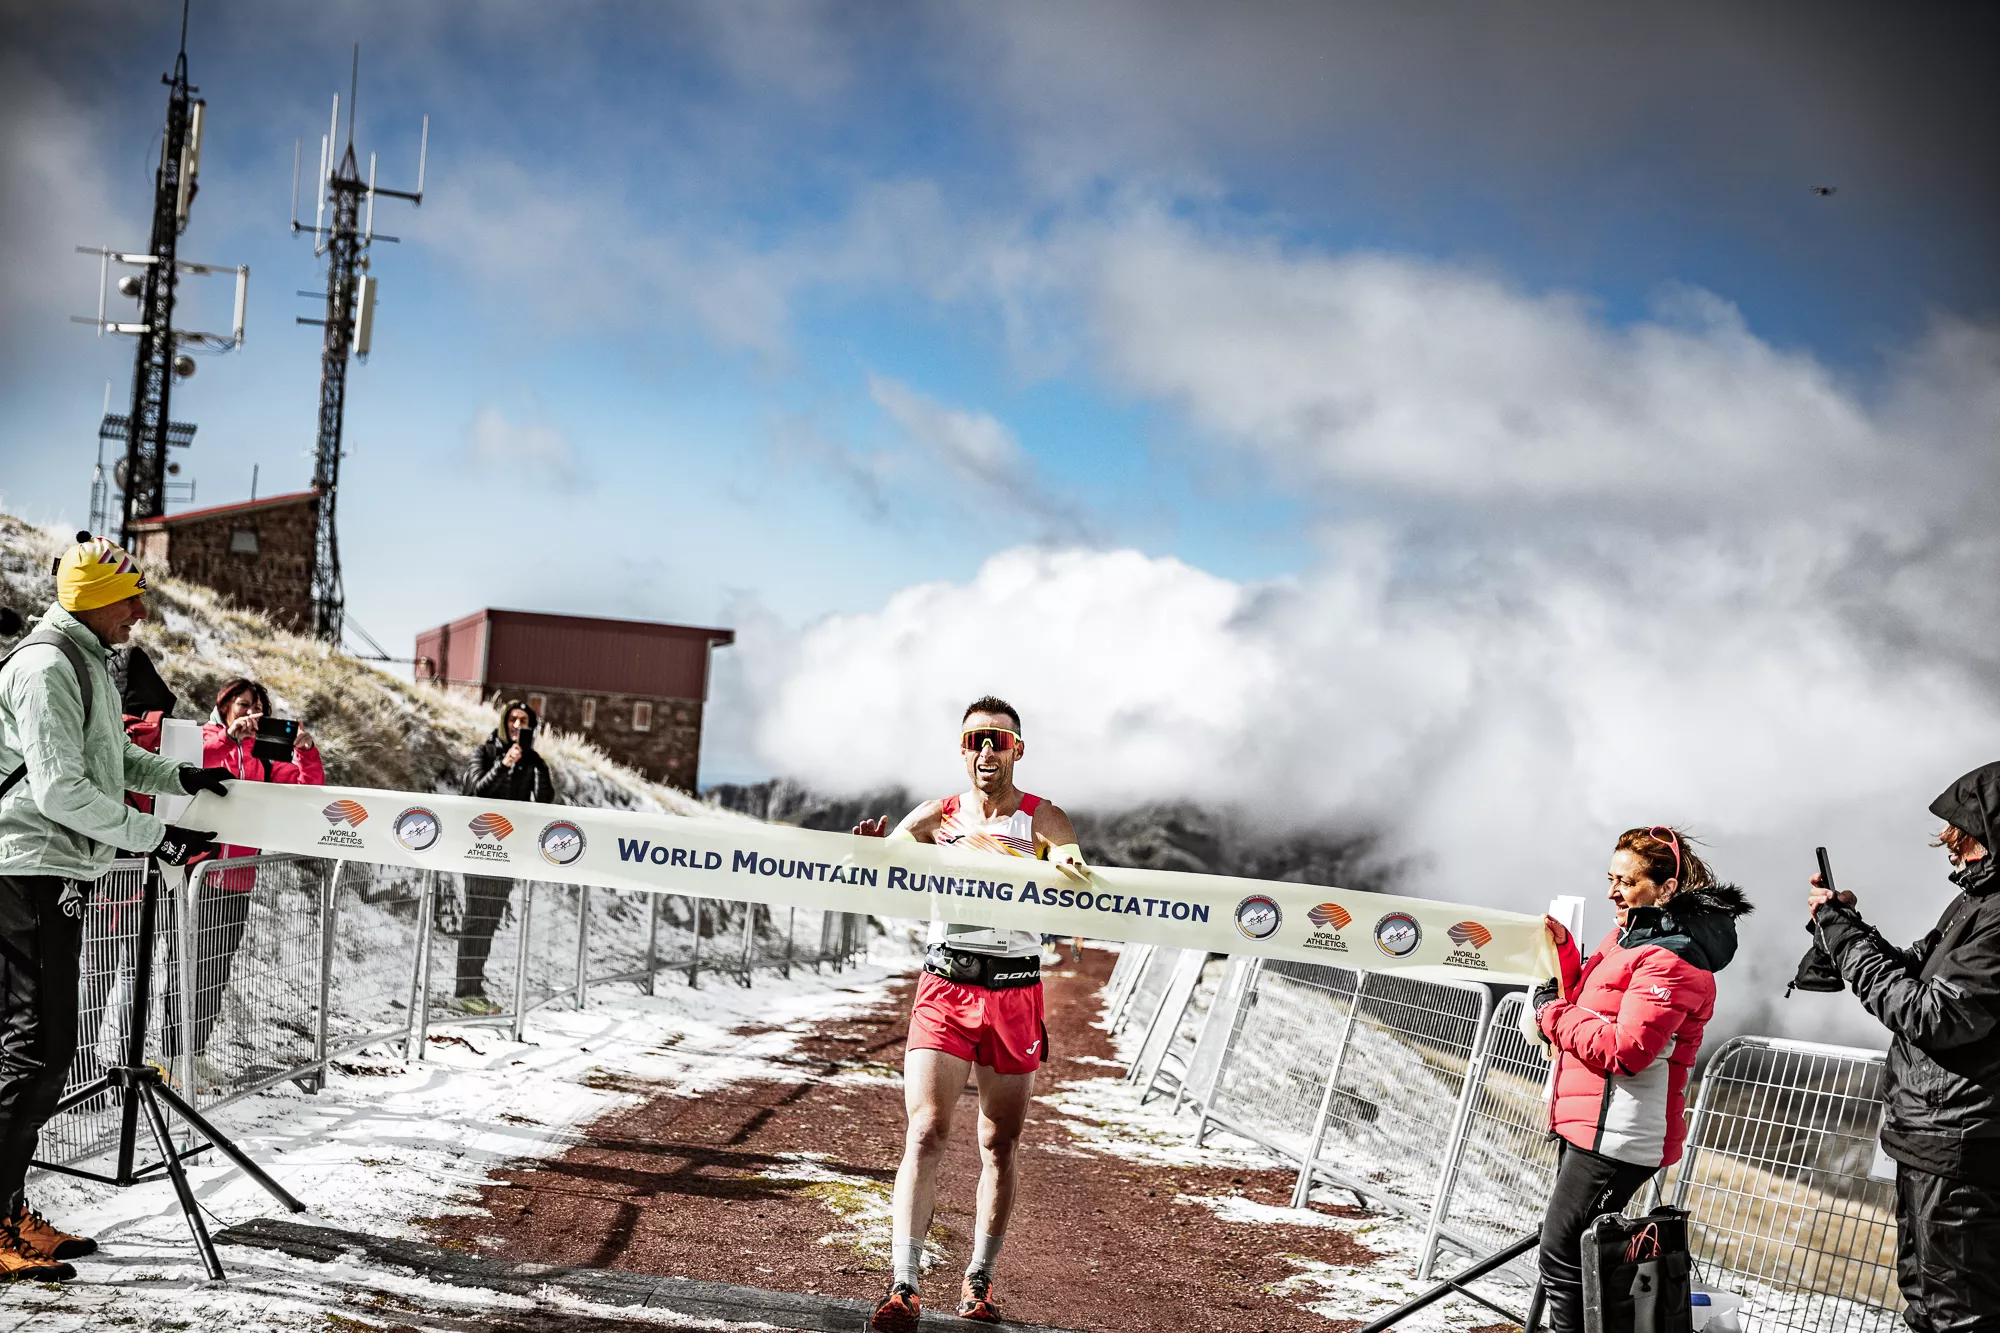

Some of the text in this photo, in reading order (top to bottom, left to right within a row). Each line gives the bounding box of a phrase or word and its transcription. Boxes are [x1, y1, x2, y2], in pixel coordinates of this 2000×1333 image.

[329, 829, 357, 838] WORLD
[475, 843, 503, 851] WORLD
[618, 838, 1210, 923] WORLD MOUNTAIN RUNNING ASSOCIATION
[1313, 932, 1341, 941] WORLD
[1453, 950, 1481, 959] WORLD
